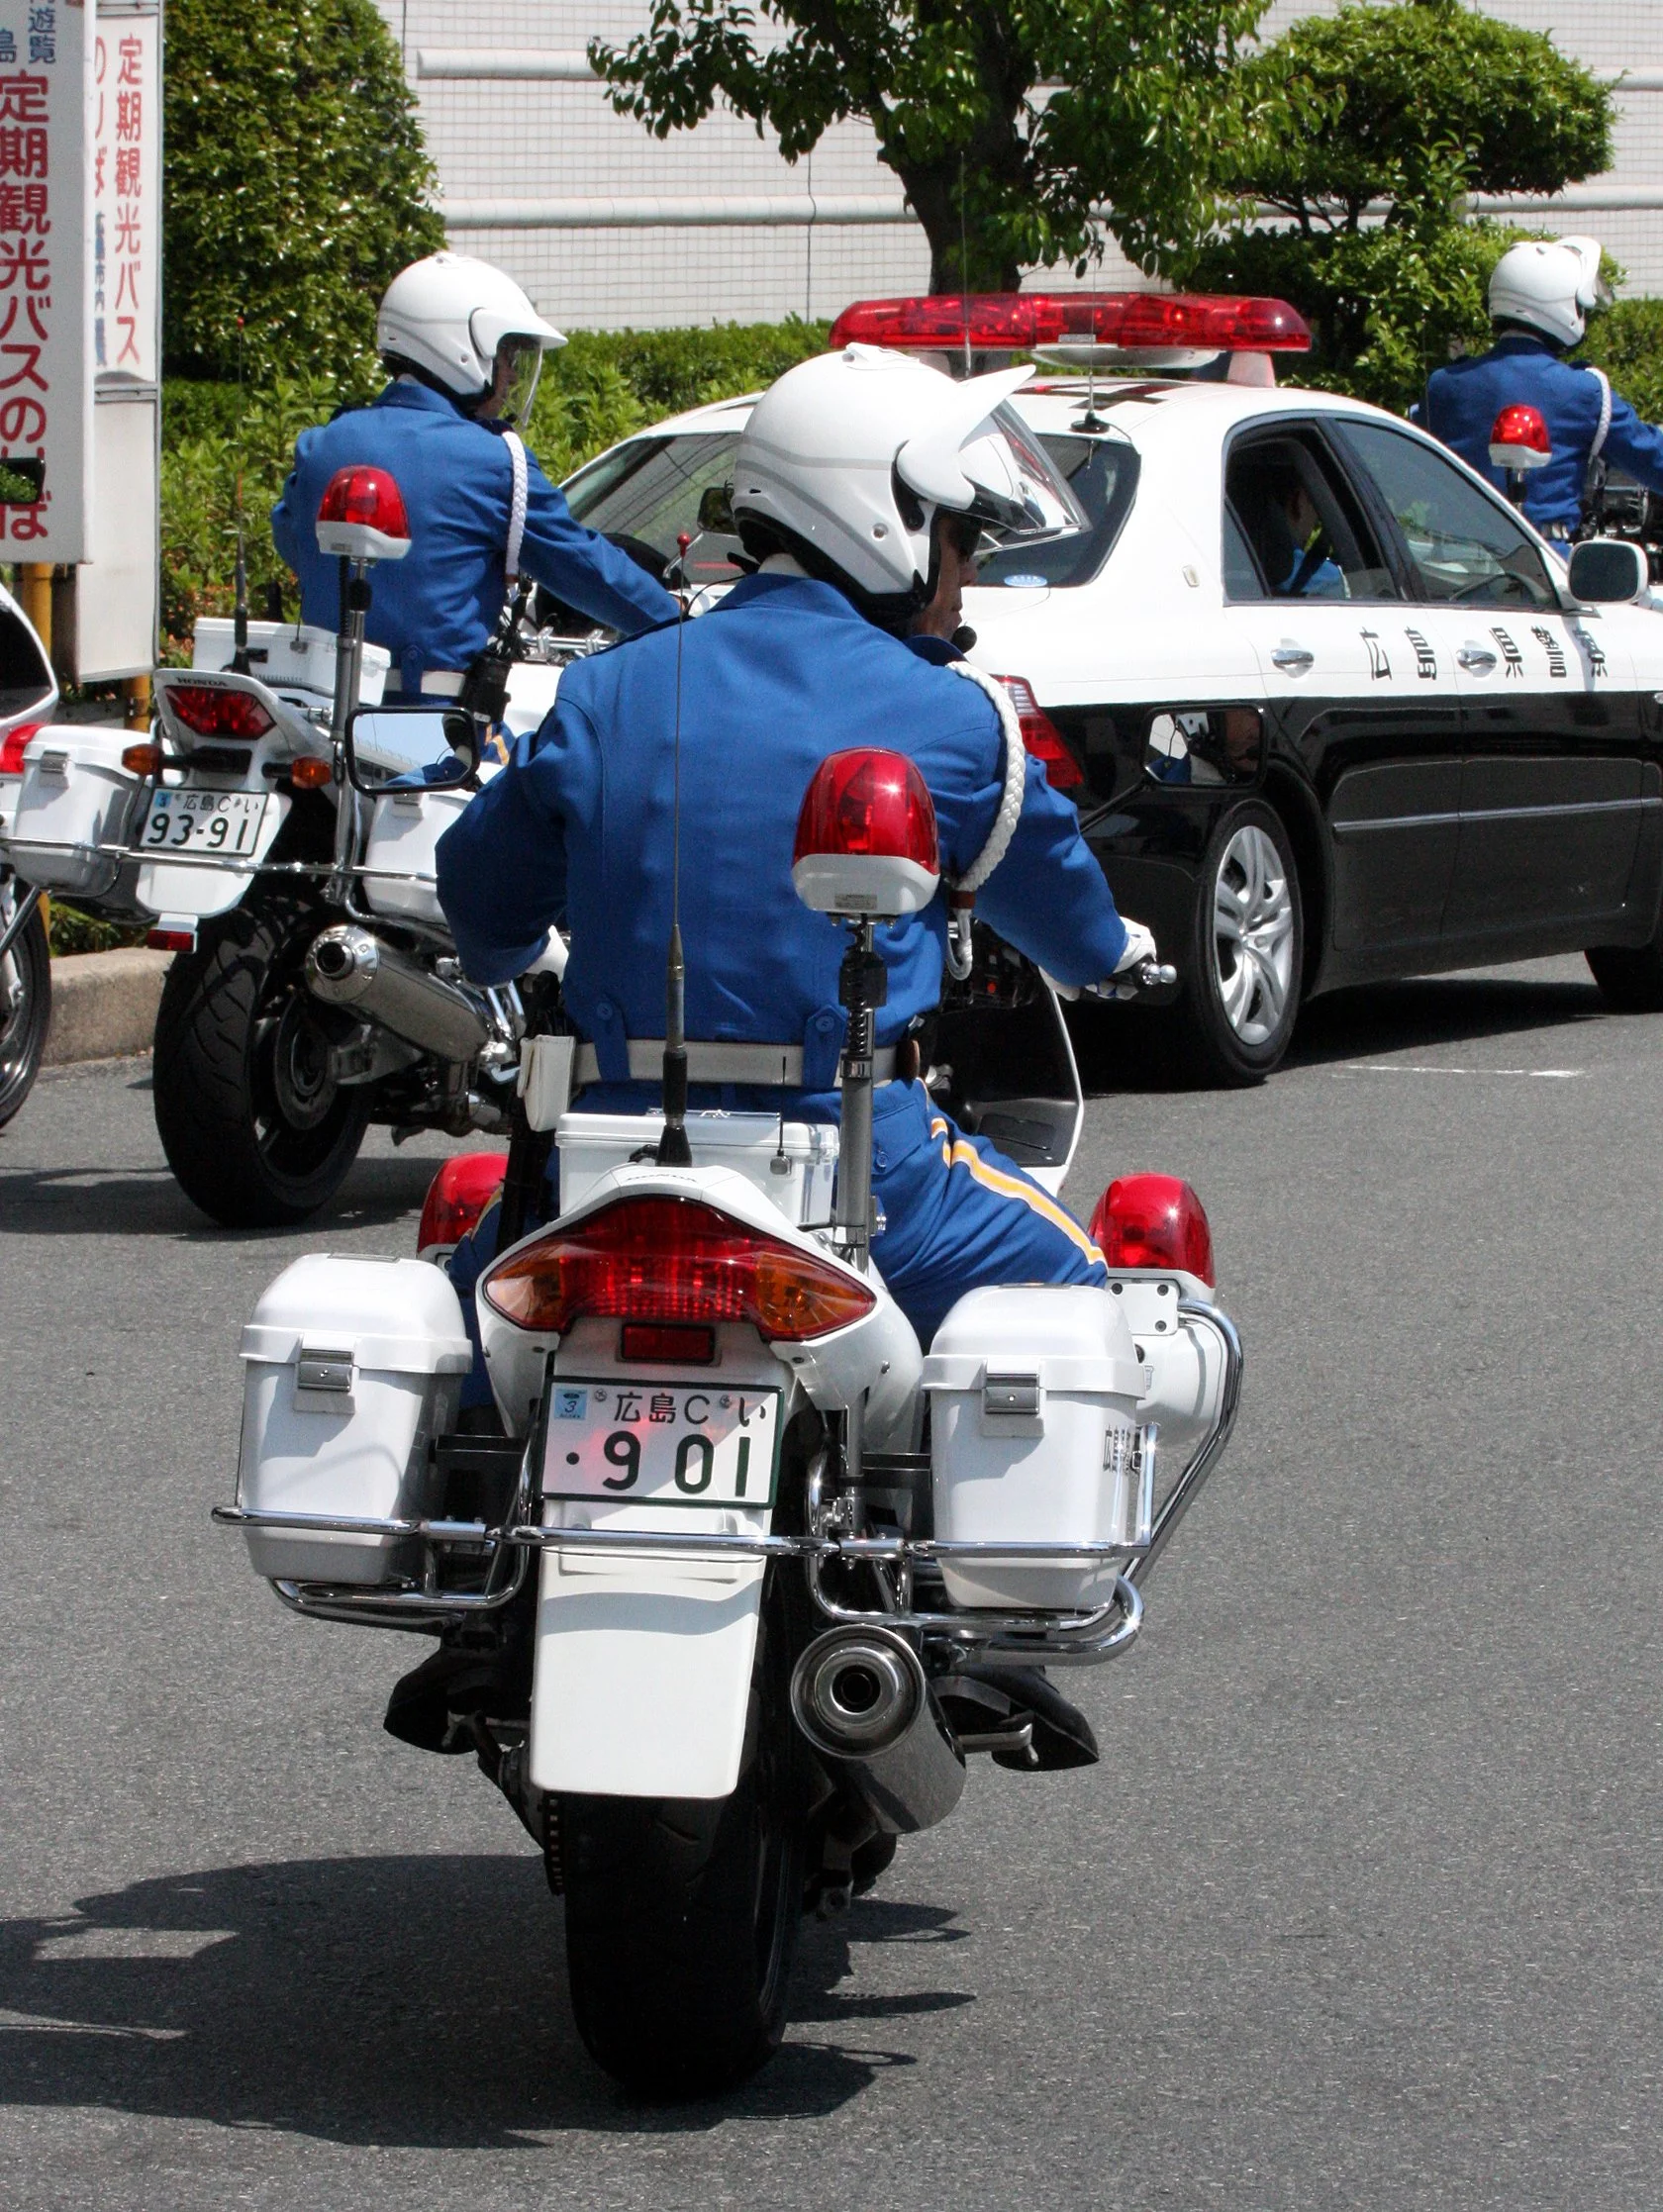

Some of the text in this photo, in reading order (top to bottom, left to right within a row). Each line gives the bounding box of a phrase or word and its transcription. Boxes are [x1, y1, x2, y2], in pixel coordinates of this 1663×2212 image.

[28, 0, 56, 63] 遊覧
[115, 33, 143, 365] 定期観光バス
[0, 69, 51, 540] 定期観光バスのば
[176, 677, 228, 687] HONDA
[147, 814, 248, 851] 93-91
